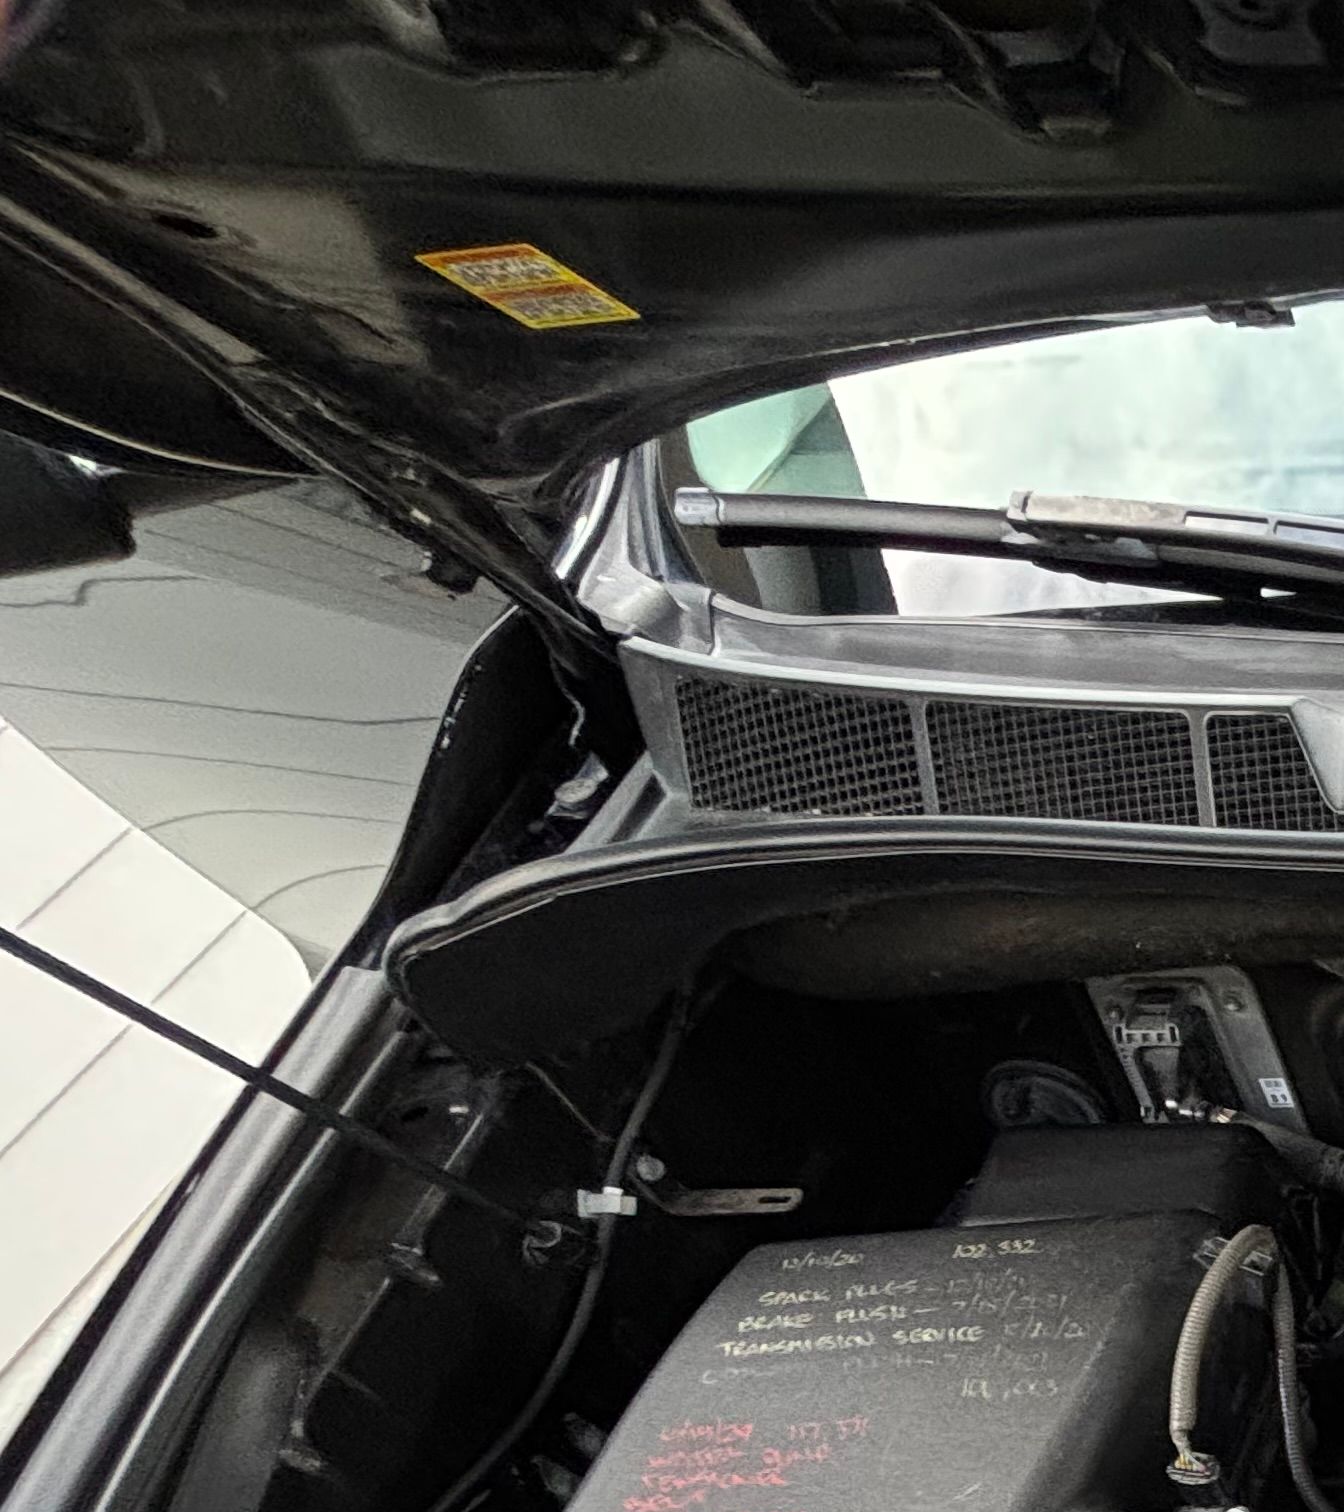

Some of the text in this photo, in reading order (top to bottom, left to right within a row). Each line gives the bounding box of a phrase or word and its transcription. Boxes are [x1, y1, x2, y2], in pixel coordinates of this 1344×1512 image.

[758, 1287, 830, 1306] SPARK
[737, 1312, 815, 1333] BRAKE
[835, 1304, 907, 1323] FLUSH
[892, 1325, 985, 1345] SERVICE
